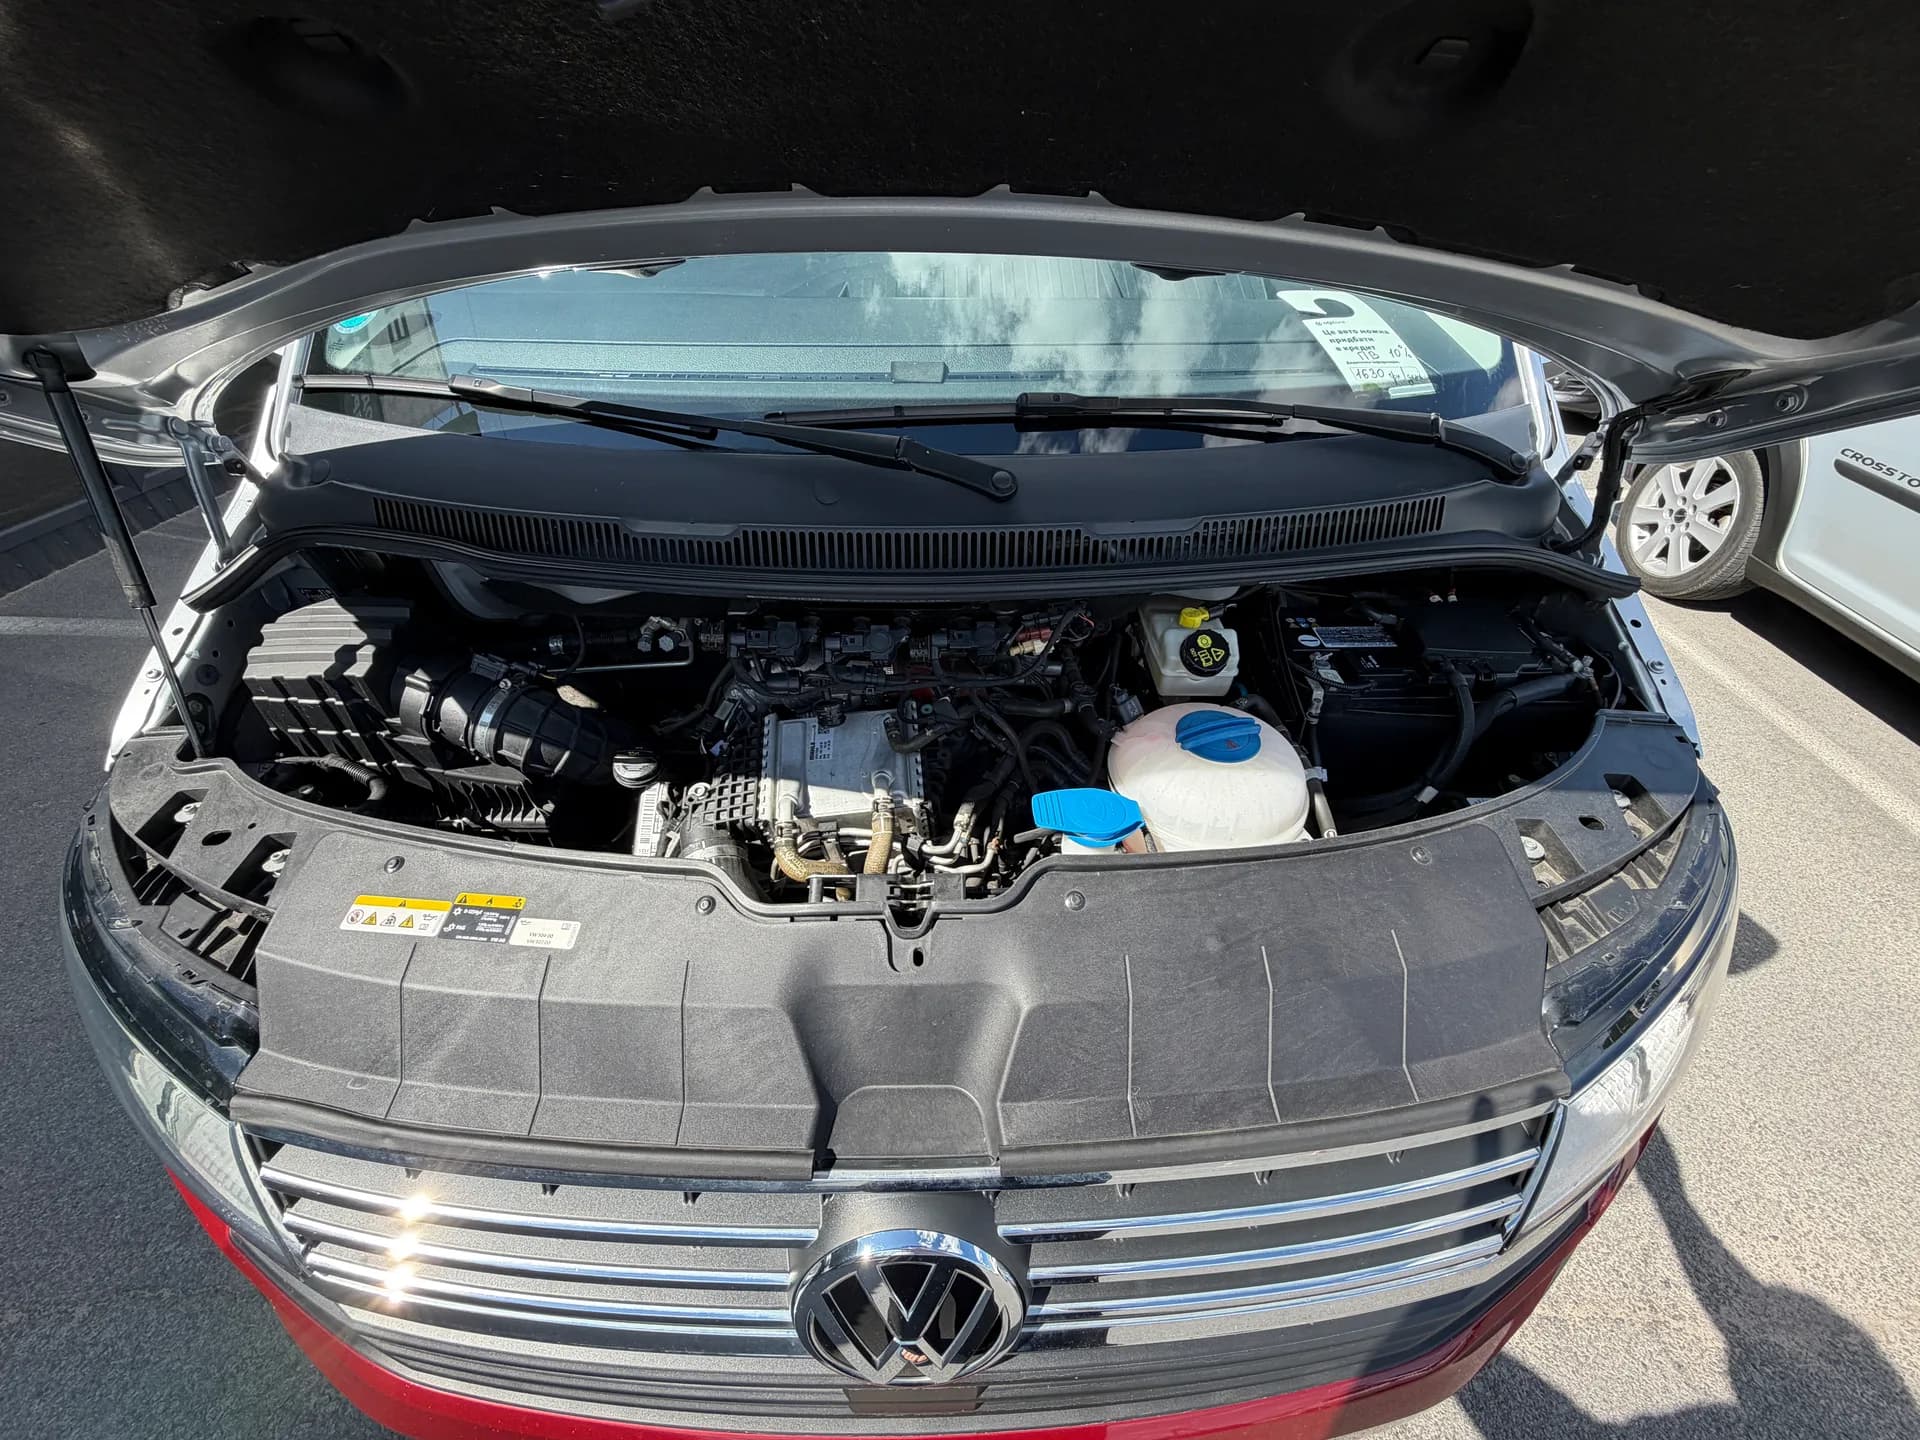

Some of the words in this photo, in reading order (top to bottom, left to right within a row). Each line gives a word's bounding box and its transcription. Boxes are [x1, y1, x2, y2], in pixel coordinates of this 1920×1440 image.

[1322, 329, 1336, 337] Це
[1329, 337, 1375, 345] придбати
[1355, 368, 1385, 380] 1630
[1840, 448, 1898, 477] CROSS
